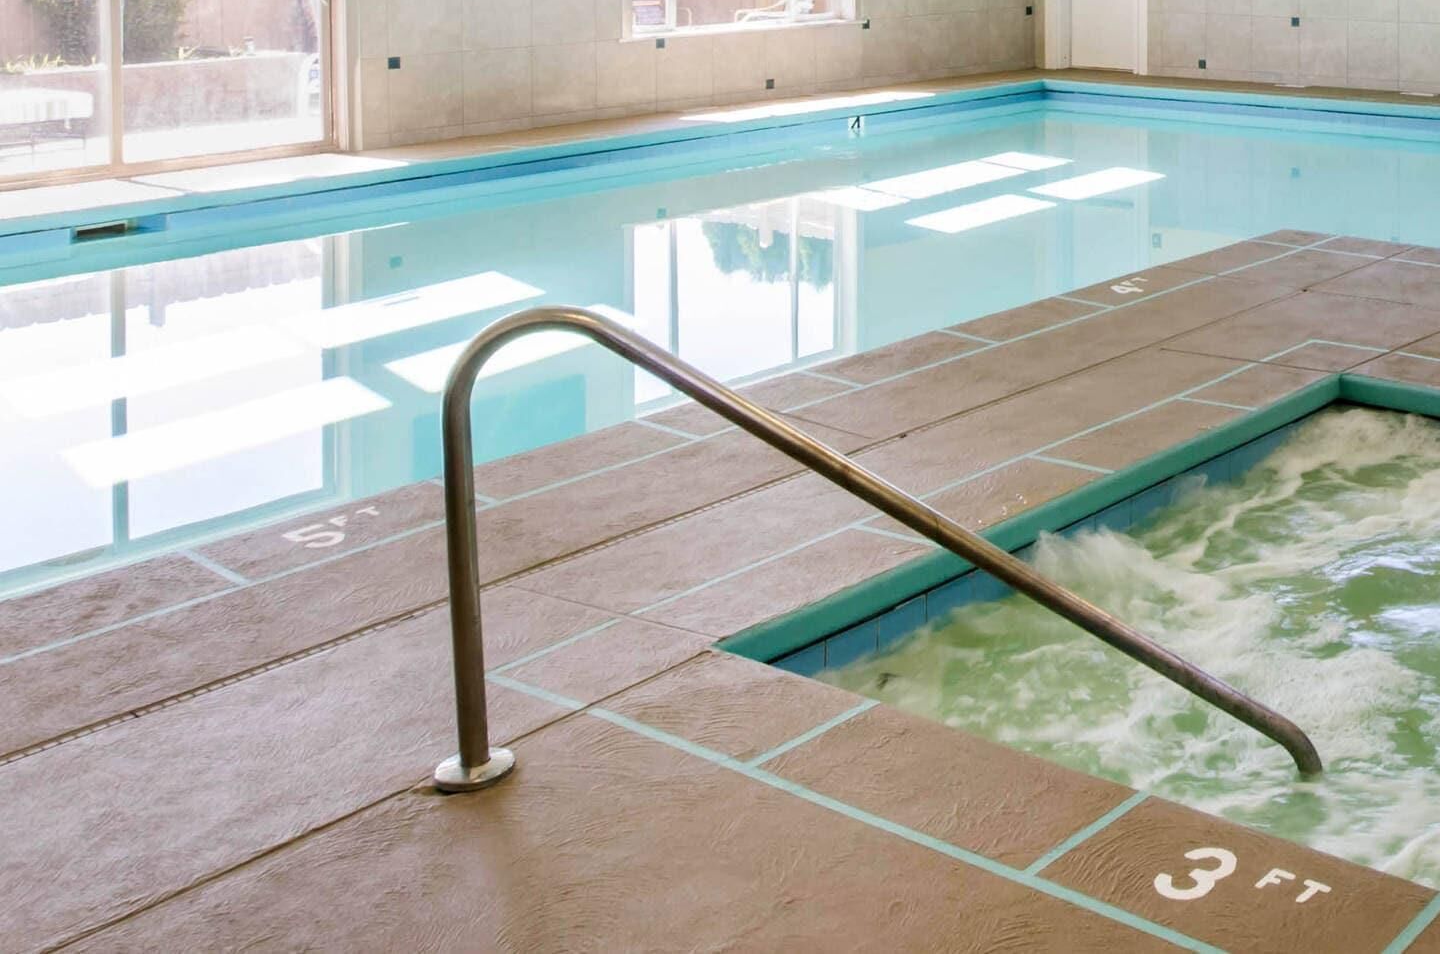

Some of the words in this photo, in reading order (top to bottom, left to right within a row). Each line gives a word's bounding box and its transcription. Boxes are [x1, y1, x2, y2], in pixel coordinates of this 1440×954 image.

[281, 524, 346, 549] 5
[328, 505, 380, 526] FT
[1153, 847, 1238, 900] 3
[1254, 867, 1332, 903] FT
